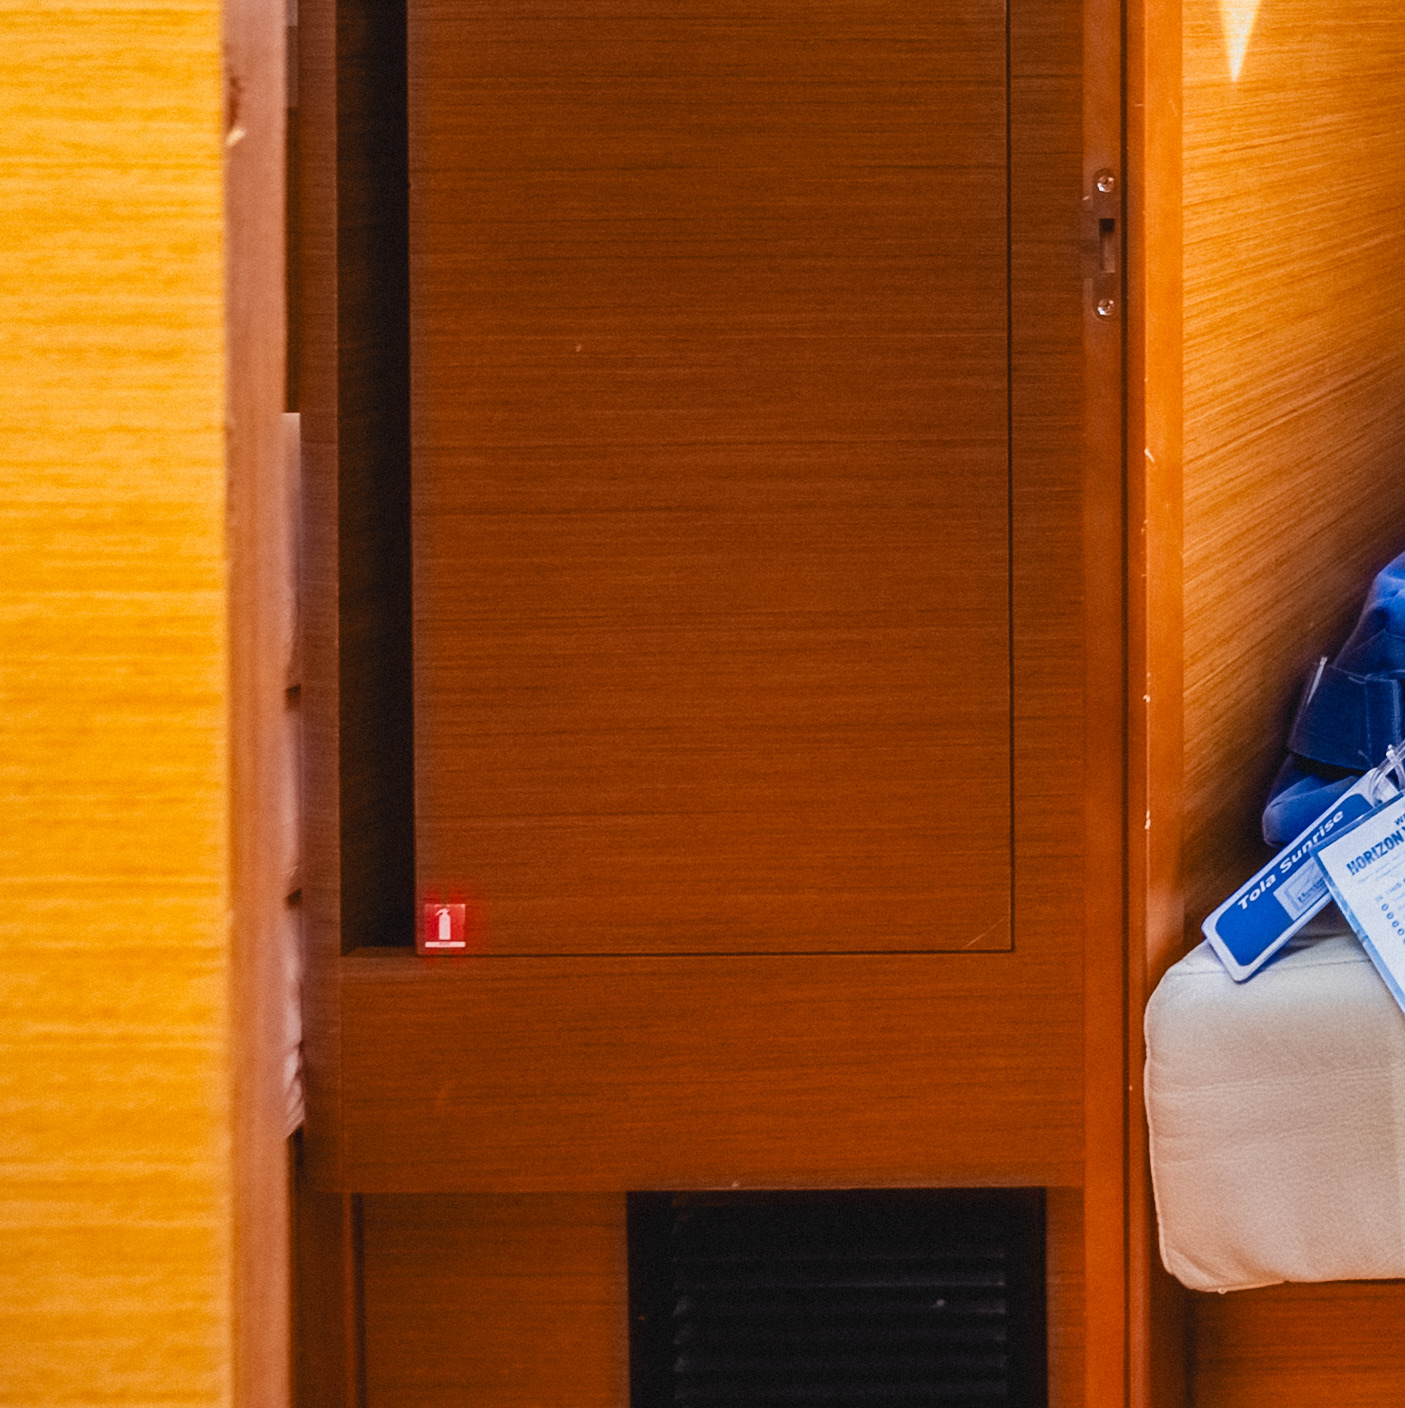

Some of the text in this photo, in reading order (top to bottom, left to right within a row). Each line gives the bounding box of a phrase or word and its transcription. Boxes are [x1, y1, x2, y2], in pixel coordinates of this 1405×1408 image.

[1236, 873, 1277, 910] Tola
[1276, 809, 1345, 874] Sunrise
[1345, 829, 1405, 876] HORIZON
